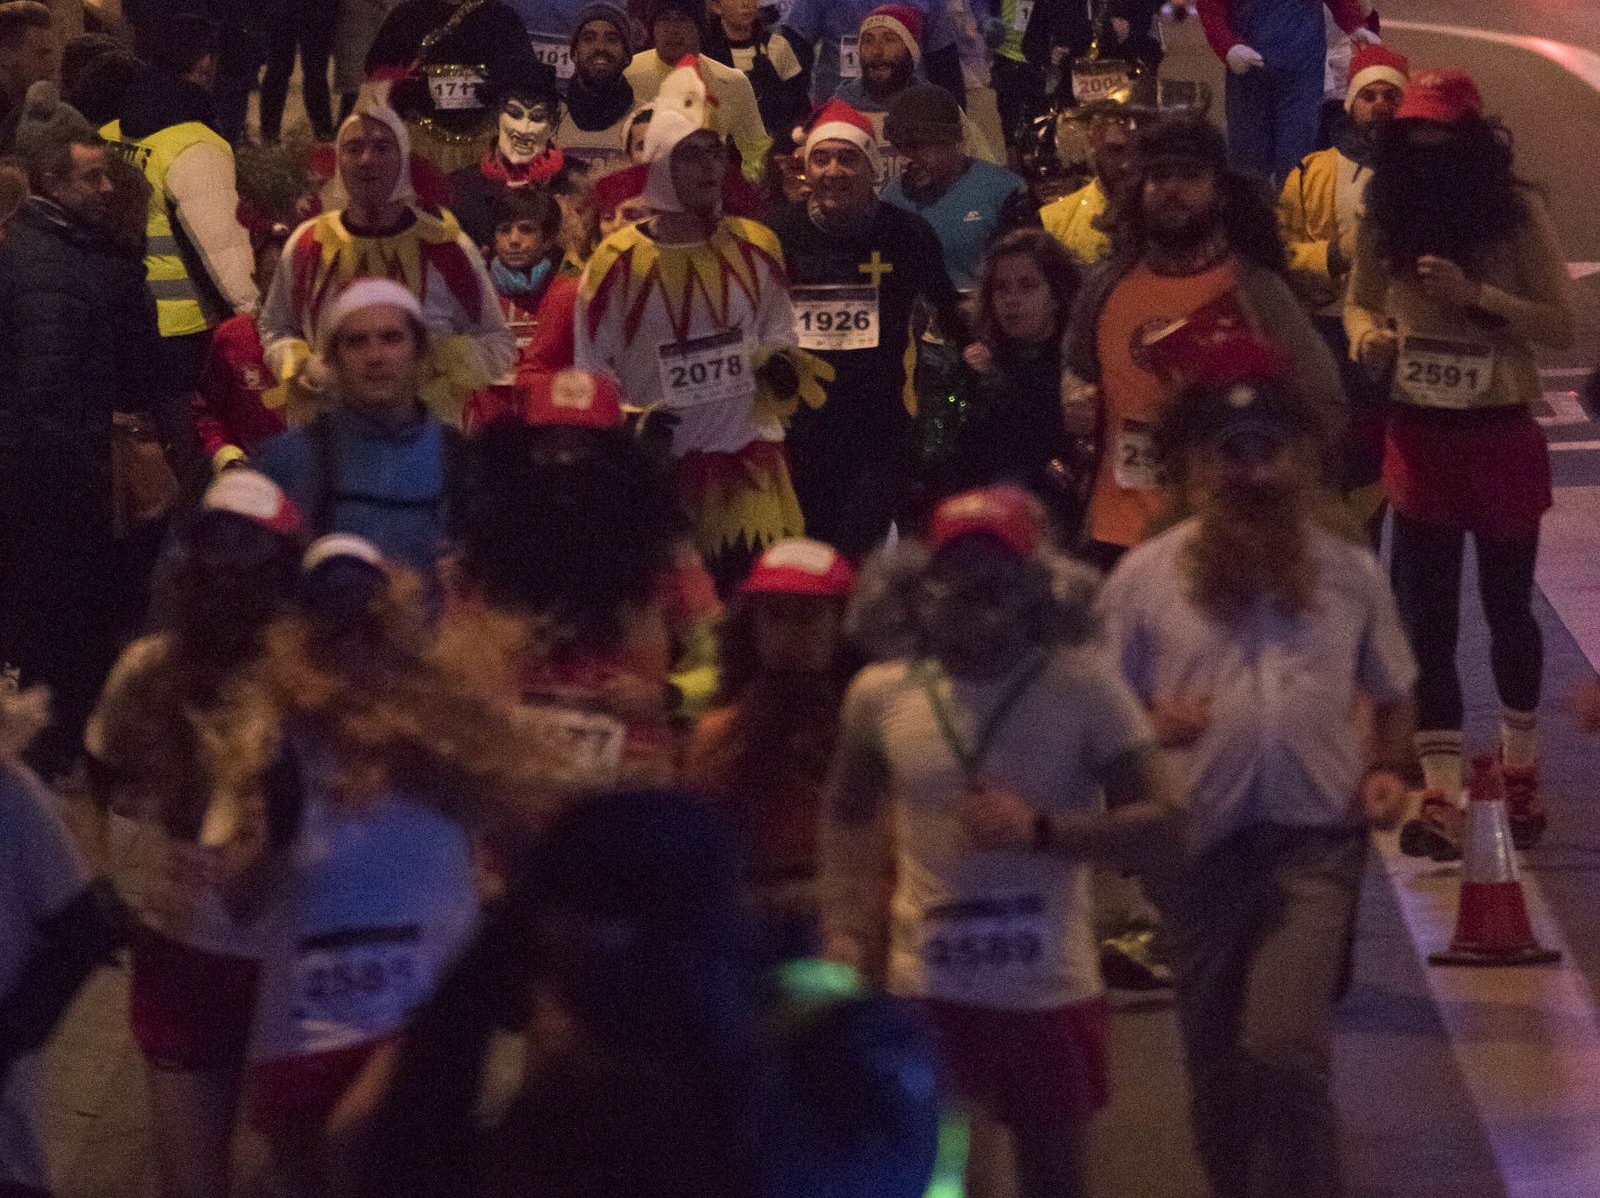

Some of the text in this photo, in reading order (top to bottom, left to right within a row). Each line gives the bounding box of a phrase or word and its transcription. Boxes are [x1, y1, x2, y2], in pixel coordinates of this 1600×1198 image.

[799, 310, 870, 332] 1926
[669, 355, 742, 388] 2078
[1406, 361, 1478, 389] 2591
